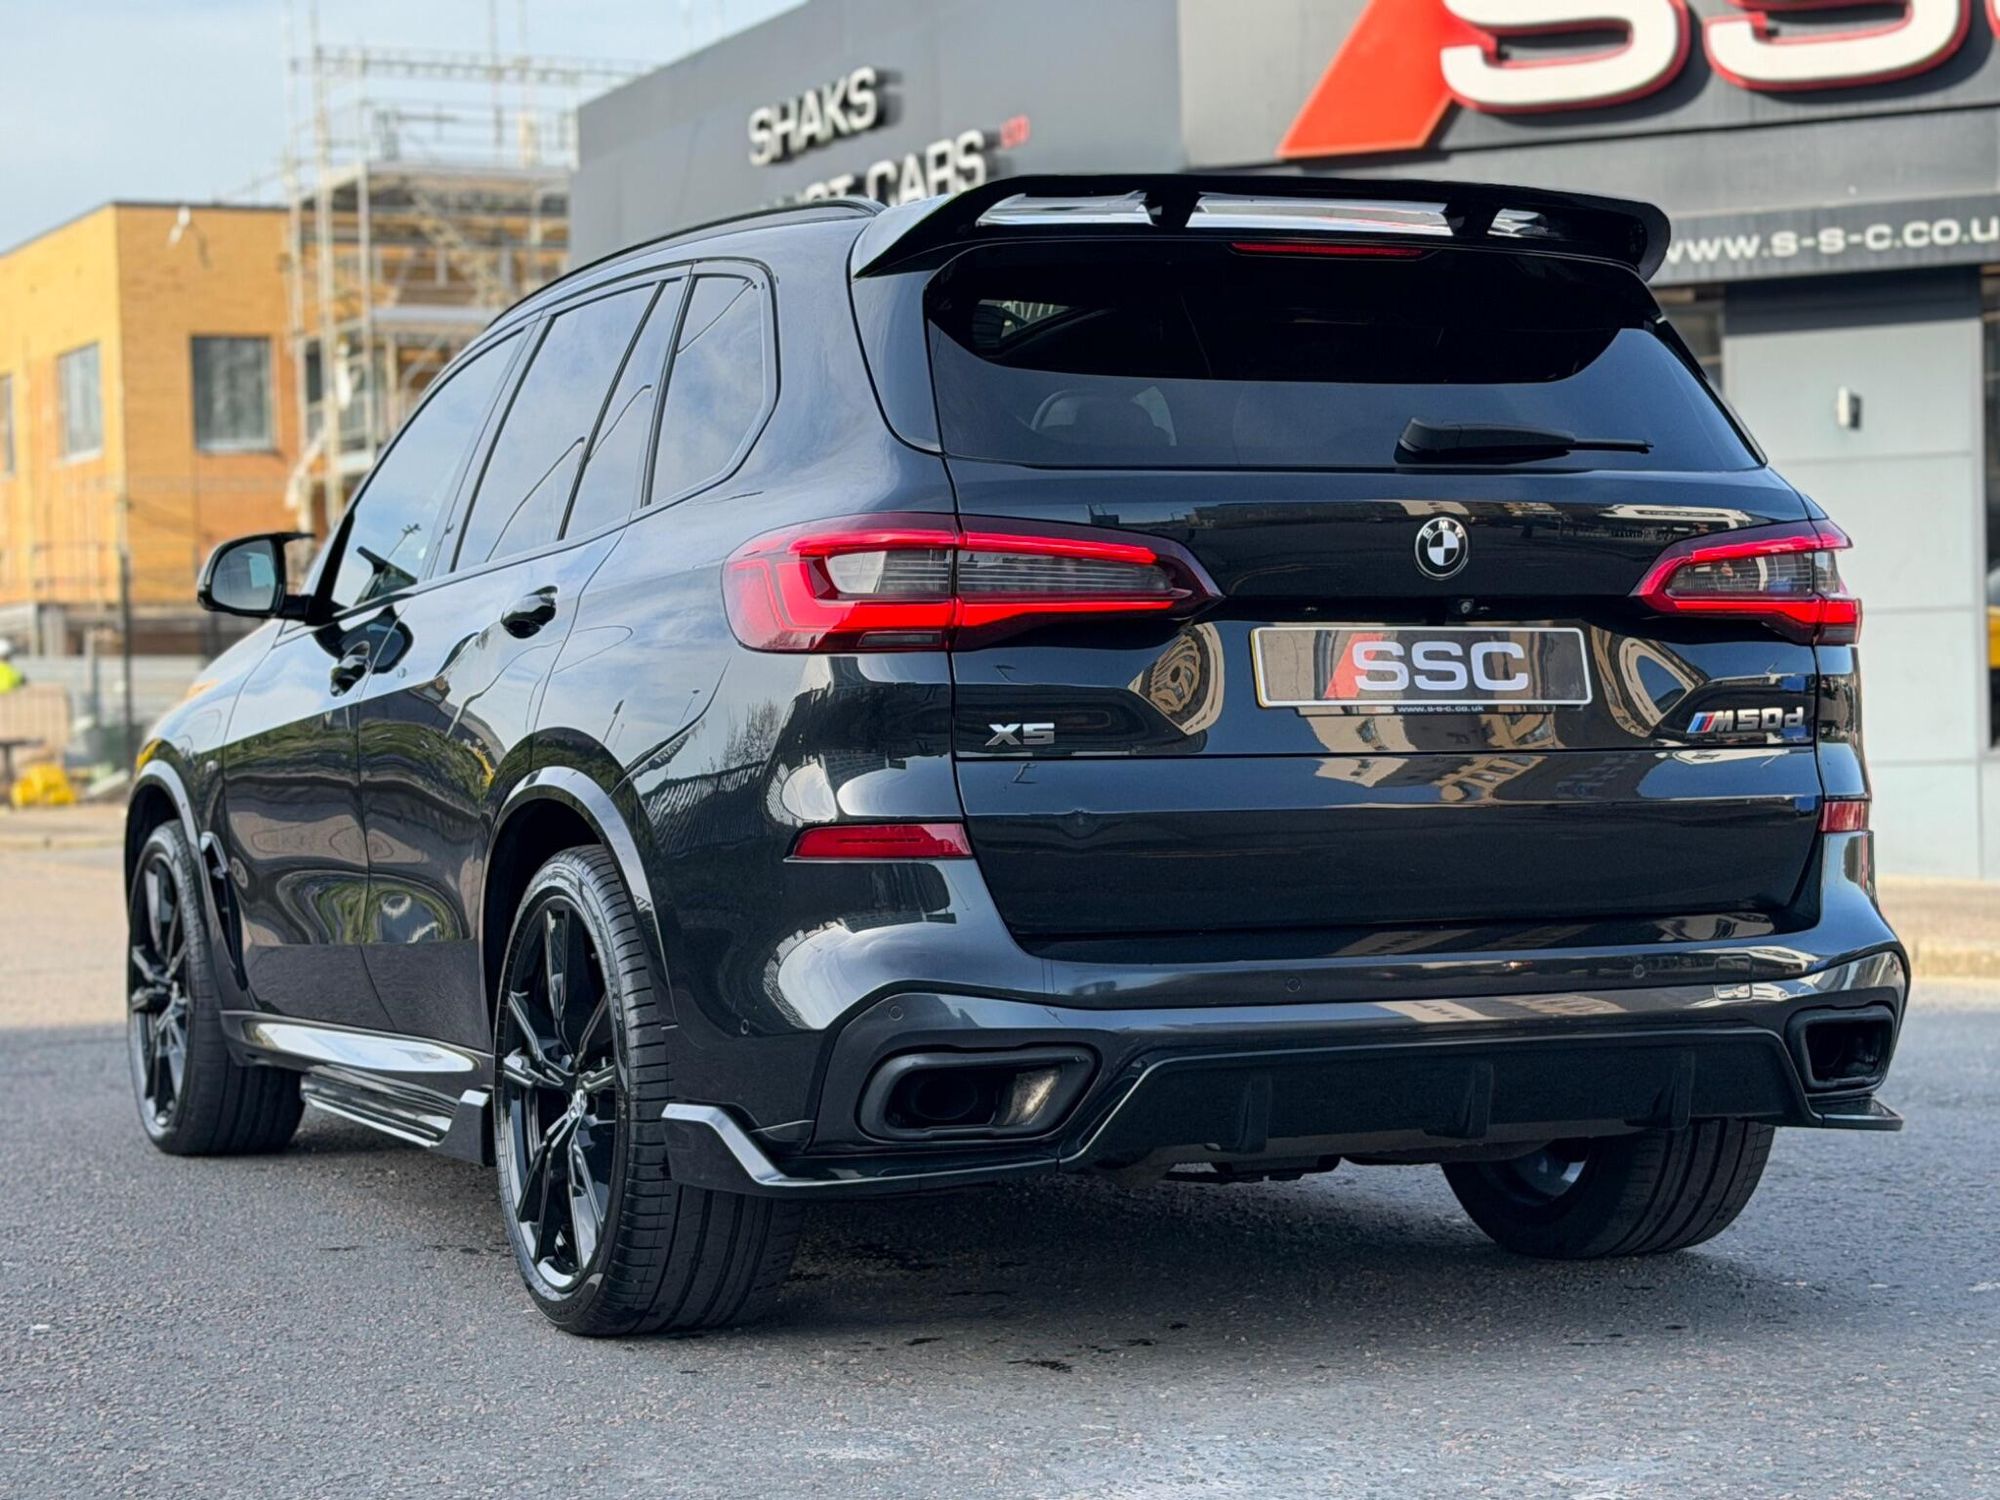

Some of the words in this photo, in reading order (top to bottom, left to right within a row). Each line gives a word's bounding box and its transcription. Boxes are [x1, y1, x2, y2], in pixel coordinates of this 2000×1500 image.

[1440, 0, 2000, 113] SS
[749, 66, 877, 166] SHAKS
[868, 130, 987, 206] CARS
[1352, 641, 1529, 691] SSC
[985, 722, 1055, 746] X5
[1690, 706, 1804, 733] M50d
